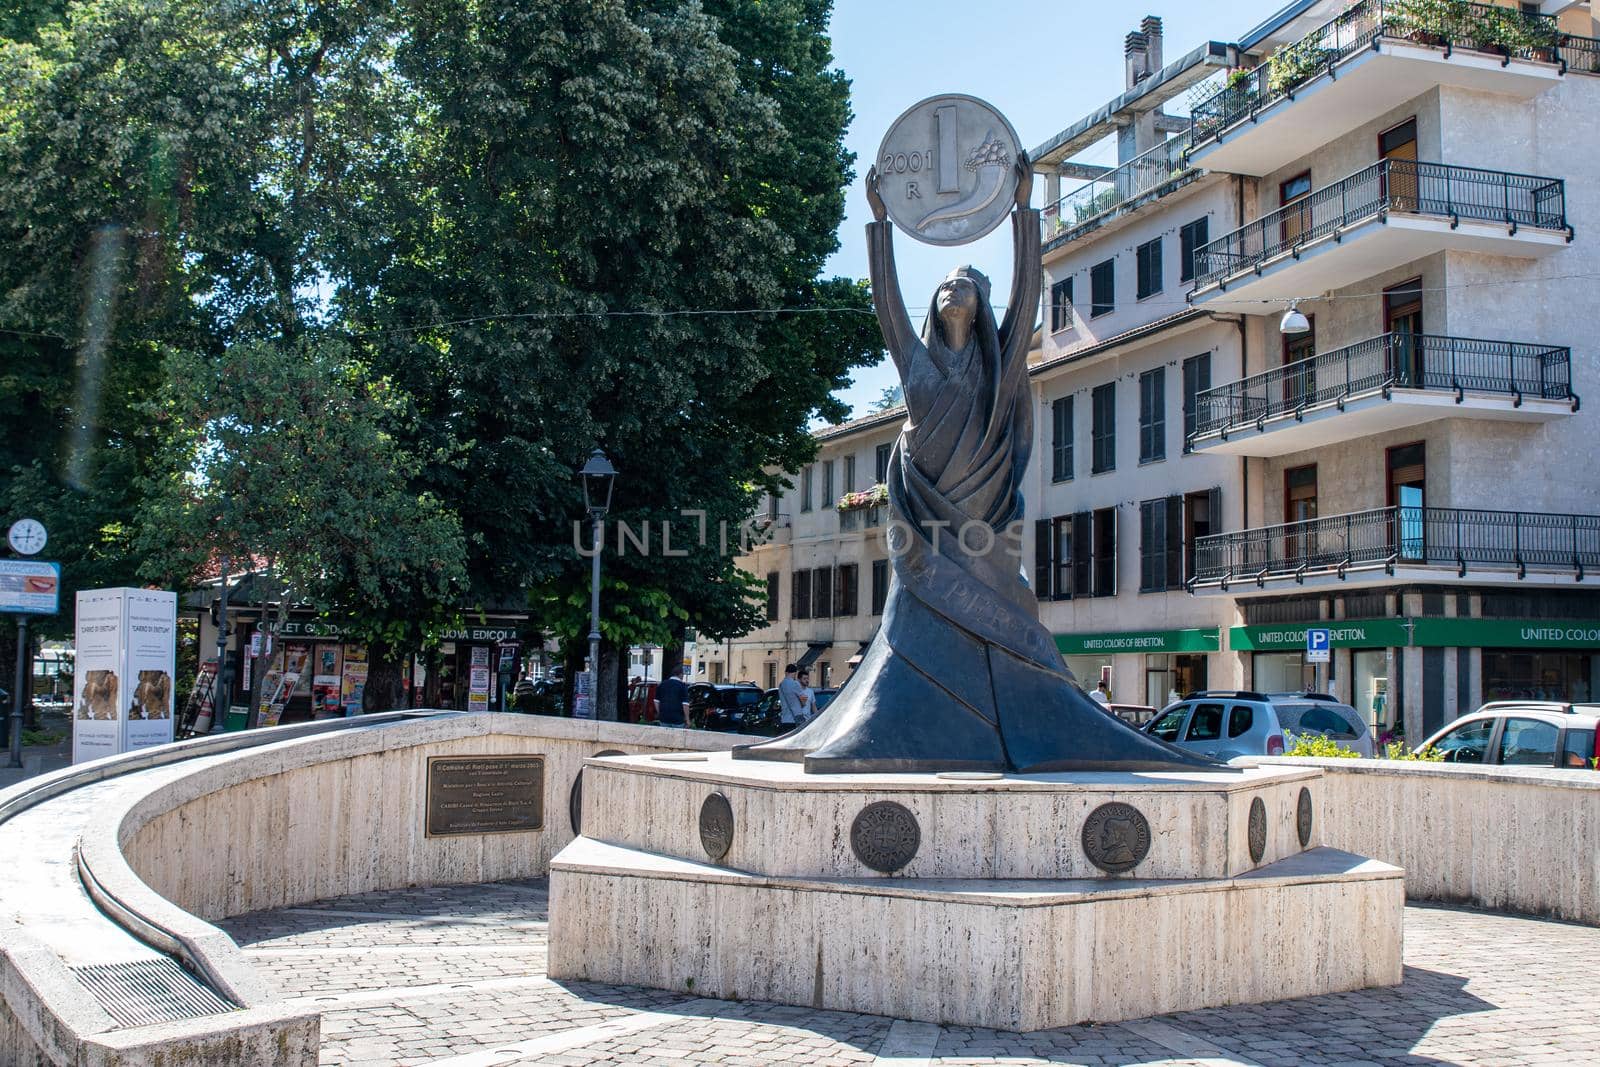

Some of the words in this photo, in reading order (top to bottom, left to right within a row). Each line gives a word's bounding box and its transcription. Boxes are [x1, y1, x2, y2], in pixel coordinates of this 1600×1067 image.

[883, 151, 934, 175] 2001
[905, 182, 921, 199] R
[439, 629, 469, 639] UOVA
[473, 630, 517, 640] EDICOLA
[1258, 632, 1283, 643] UNITED
[1284, 631, 1308, 642] COLOR
[1329, 628, 1366, 641] ENETTON.
[1312, 631, 1326, 649] P
[1521, 628, 1564, 640] UNITED
[1566, 629, 1600, 641] COLO
[1083, 640, 1103, 649] UNITED
[1104, 639, 1125, 649] COLORS
[1126, 639, 1132, 647] OF
